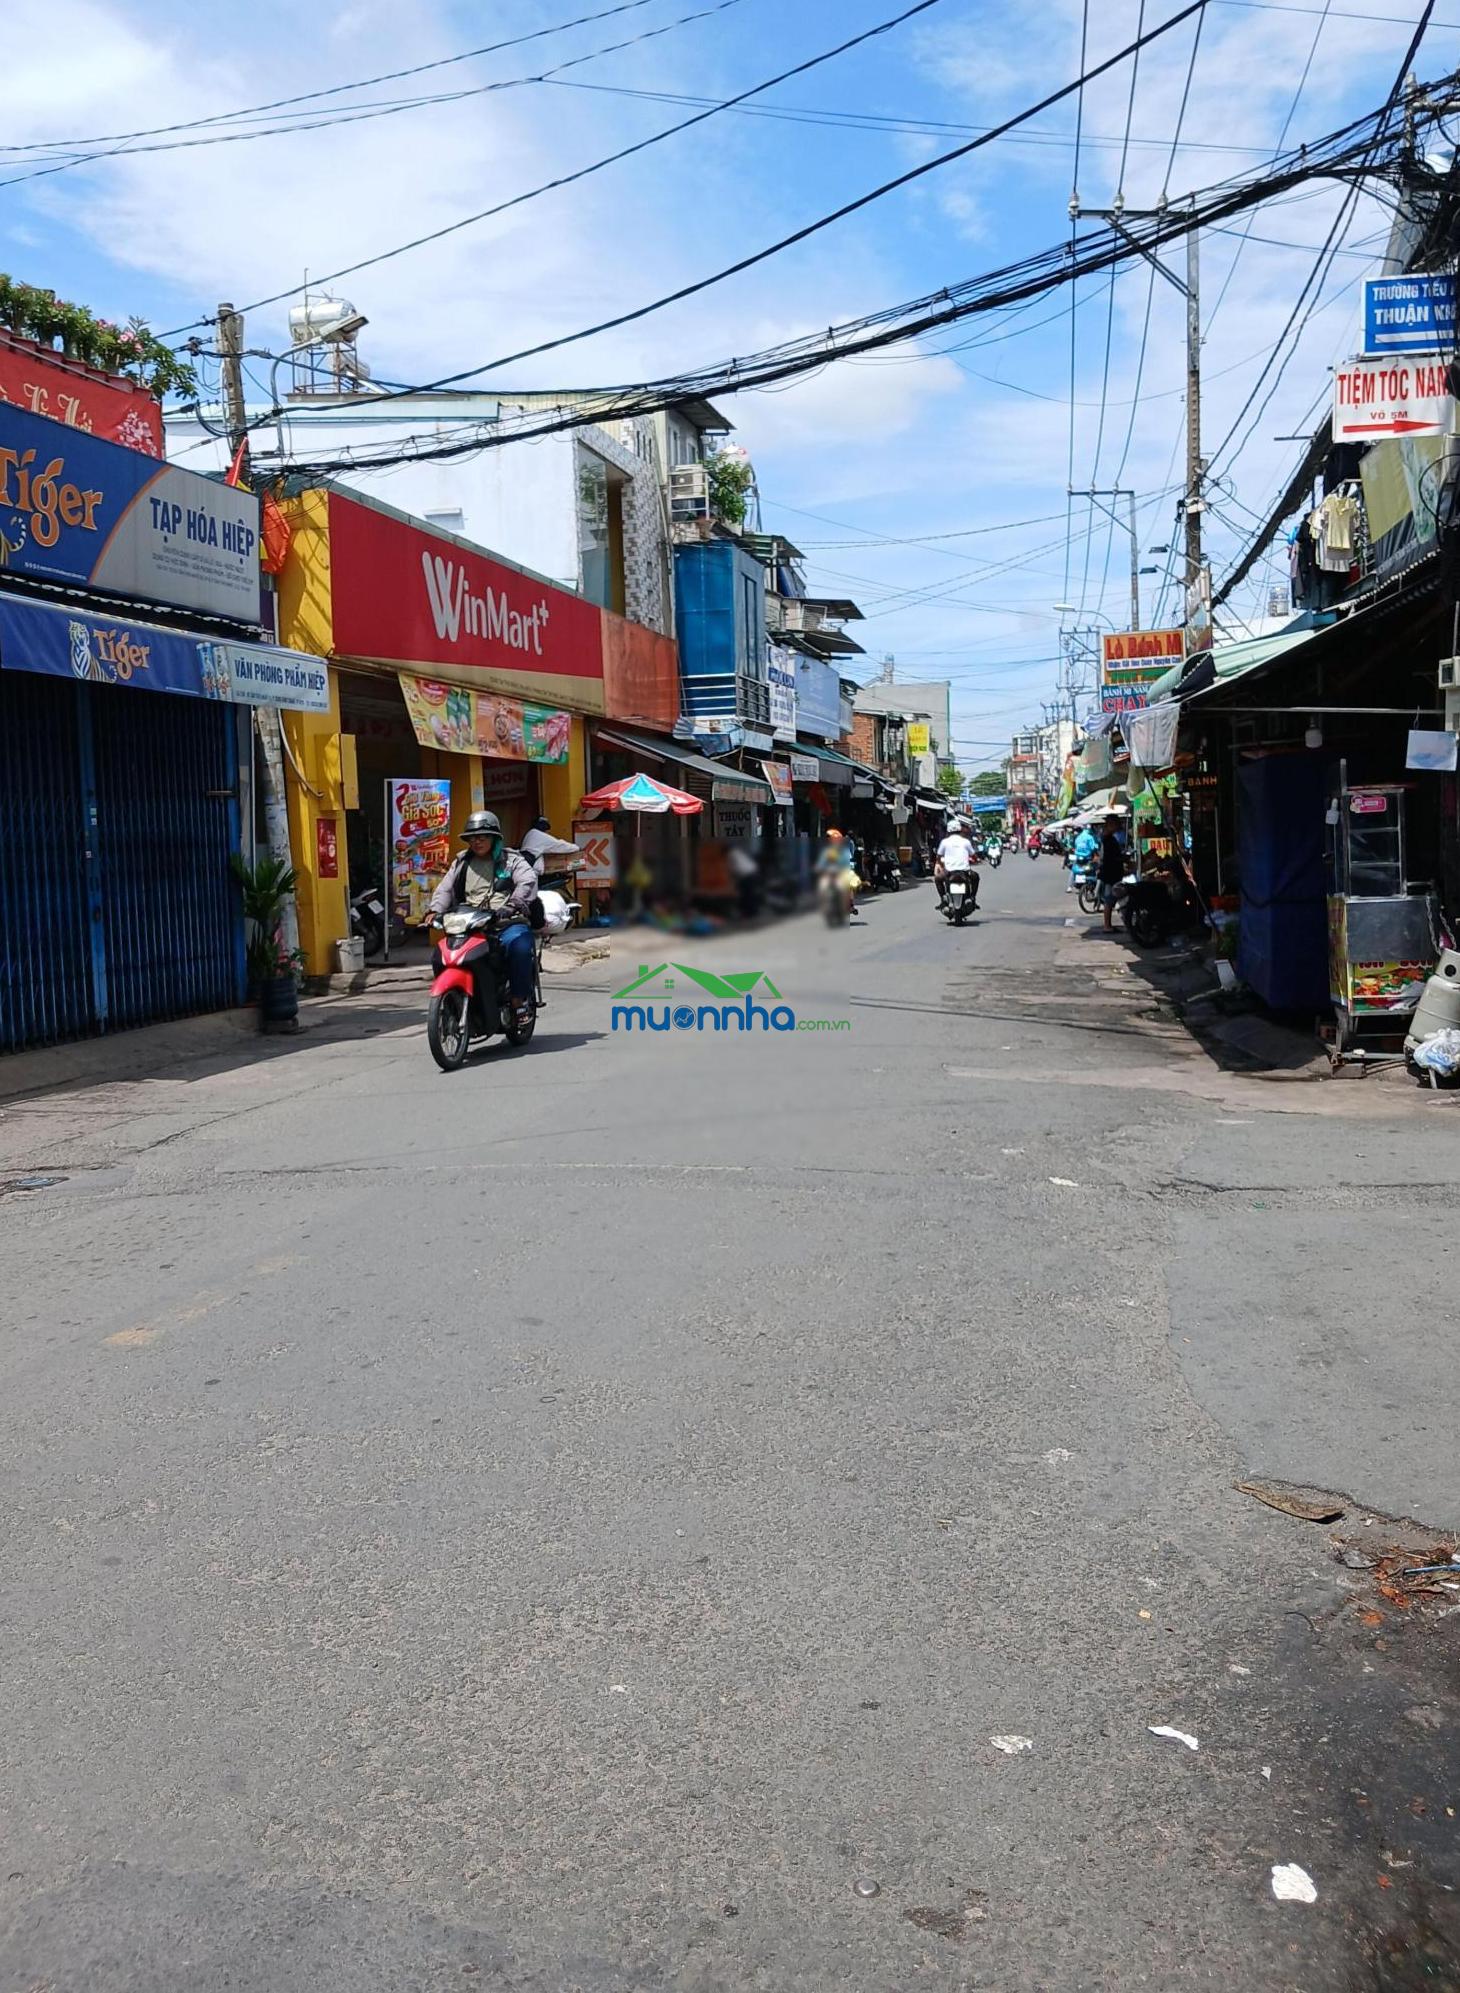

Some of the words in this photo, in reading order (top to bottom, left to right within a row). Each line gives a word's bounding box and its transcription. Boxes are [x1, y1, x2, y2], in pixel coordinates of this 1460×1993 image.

[1374, 303, 1429, 326] THUẬN
[1337, 367, 1375, 409] TIỆM
[1379, 364, 1409, 401] TÓC
[0, 445, 103, 547] Tiger
[150, 497, 182, 543] TẠP
[187, 506, 218, 547] HÓA
[222, 518, 255, 565] HIỆP
[93, 628, 150, 679] Tiger
[235, 657, 253, 679] VĂN
[254, 661, 283, 684] PHÒNG
[284, 663, 307, 689] PHẨM
[307, 670, 325, 696] HIỆP
[1103, 695, 1146, 713] CHAY
